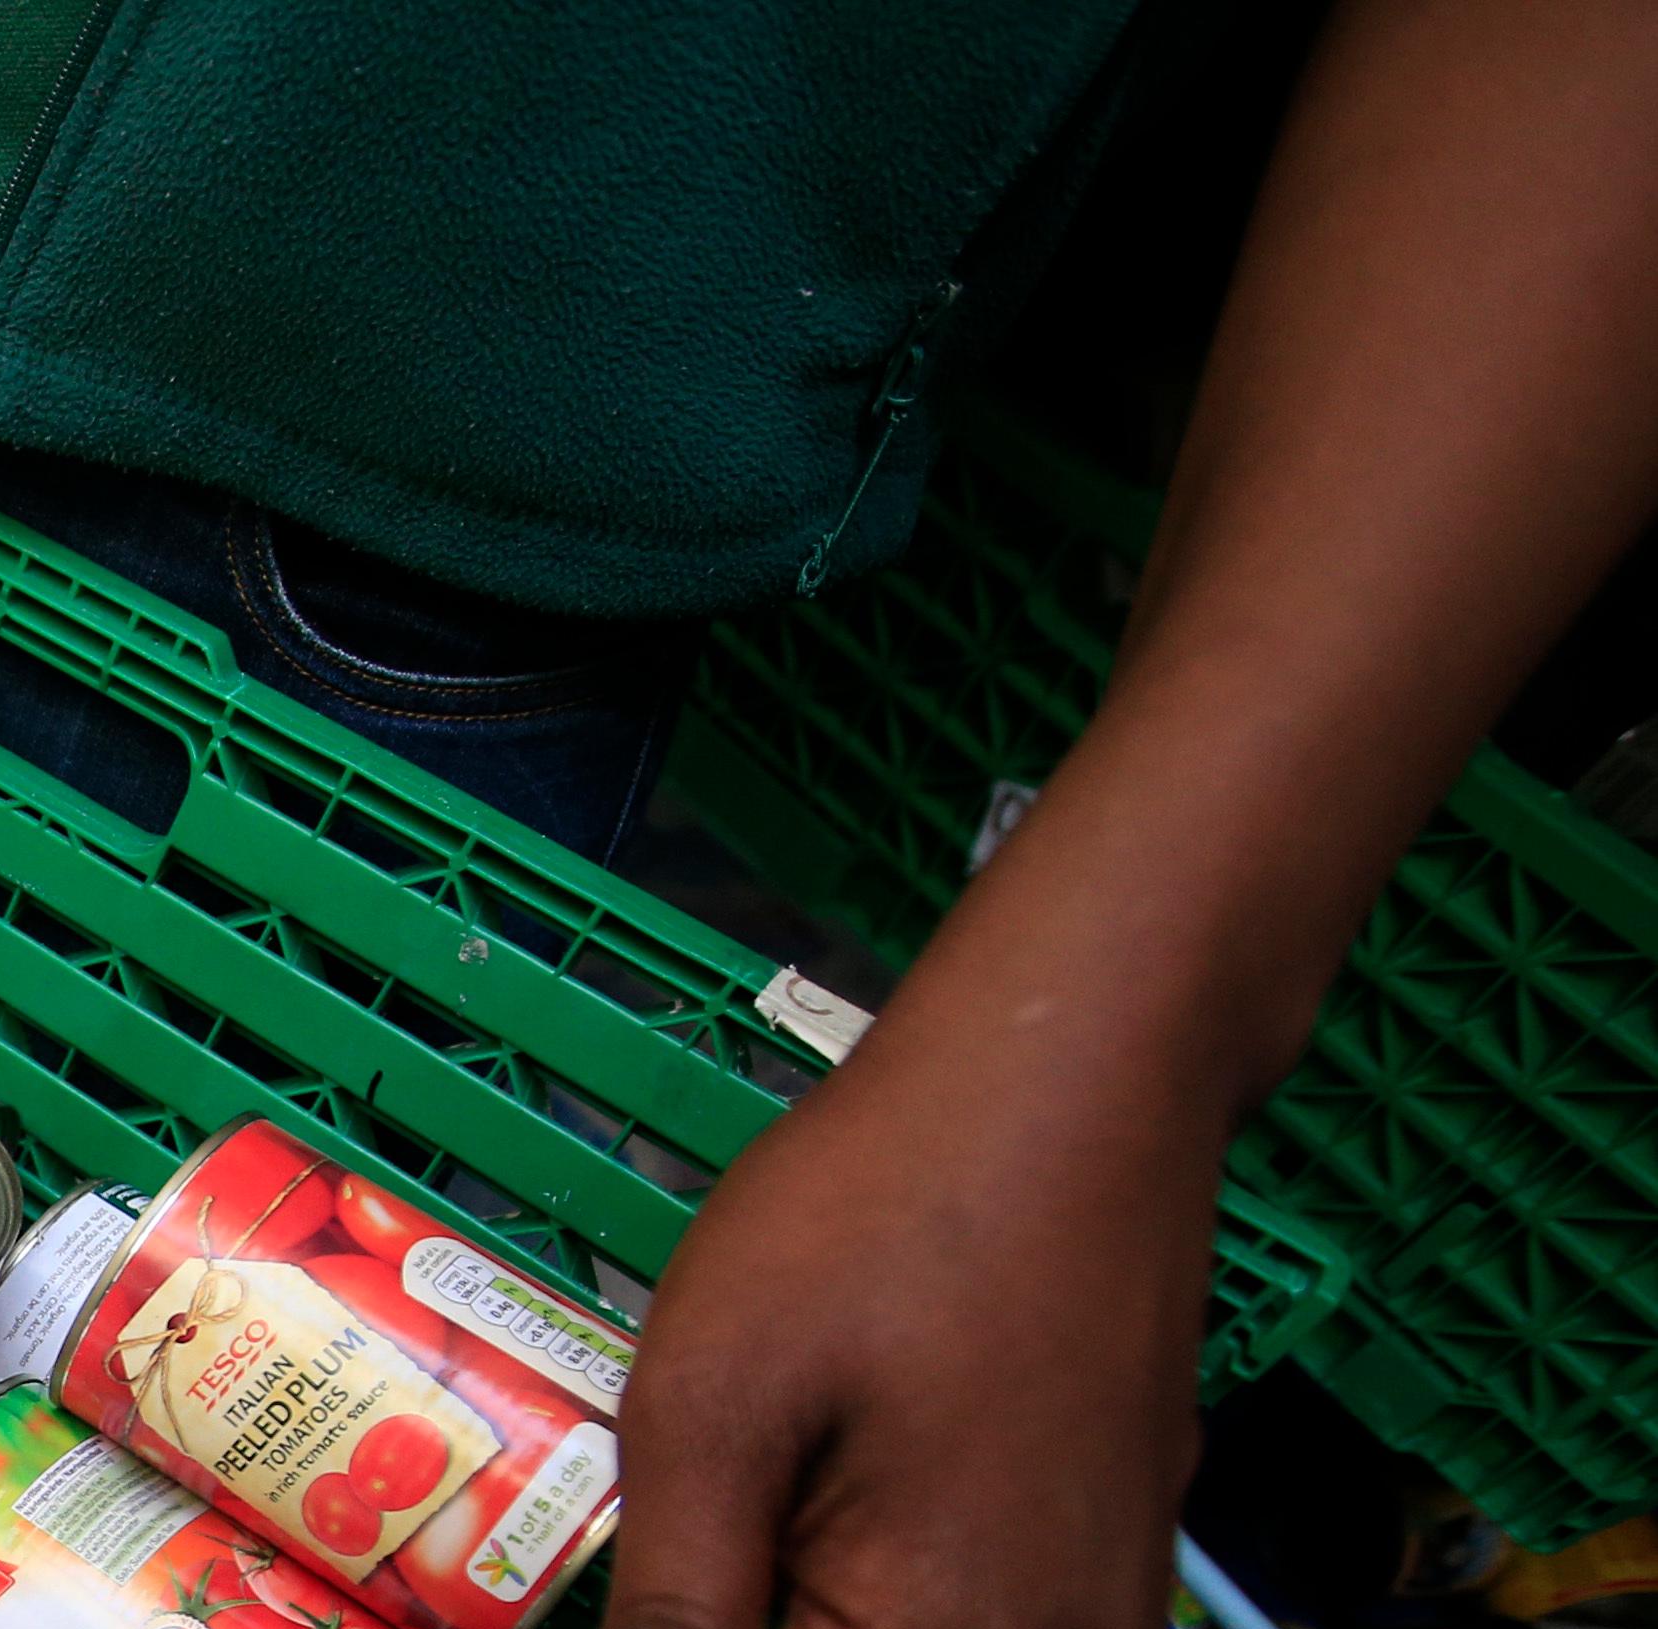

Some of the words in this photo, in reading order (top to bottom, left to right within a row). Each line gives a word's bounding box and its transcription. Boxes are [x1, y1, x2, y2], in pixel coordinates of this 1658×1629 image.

[59, 1226, 100, 1270] ingredients
[1, 1308, 32, 1345] organic,
[36, 1294, 59, 1321] Citric
[37, 1302, 68, 1339] Organic
[490, 1298, 514, 1320] 0.4g
[16, 1334, 44, 1368] Tomato
[185, 1318, 272, 1403] TESCO
[567, 1344, 592, 1366] 8.0g
[216, 1386, 294, 1481] PEELED
[285, 1325, 367, 1415] PLUM
[223, 1353, 297, 1429] ITALIAN
[259, 1385, 350, 1473] TOMATOES
[265, 1483, 281, 1504] in
[276, 1461, 302, 1491] rich
[296, 1417, 349, 1473] tomato
[349, 1378, 390, 1423] sauce
[514, 1509, 540, 1536] of
[531, 1495, 552, 1515] 5
[555, 1446, 594, 1485] day
[531, 1520, 556, 1546] half
[571, 1472, 593, 1498] can
